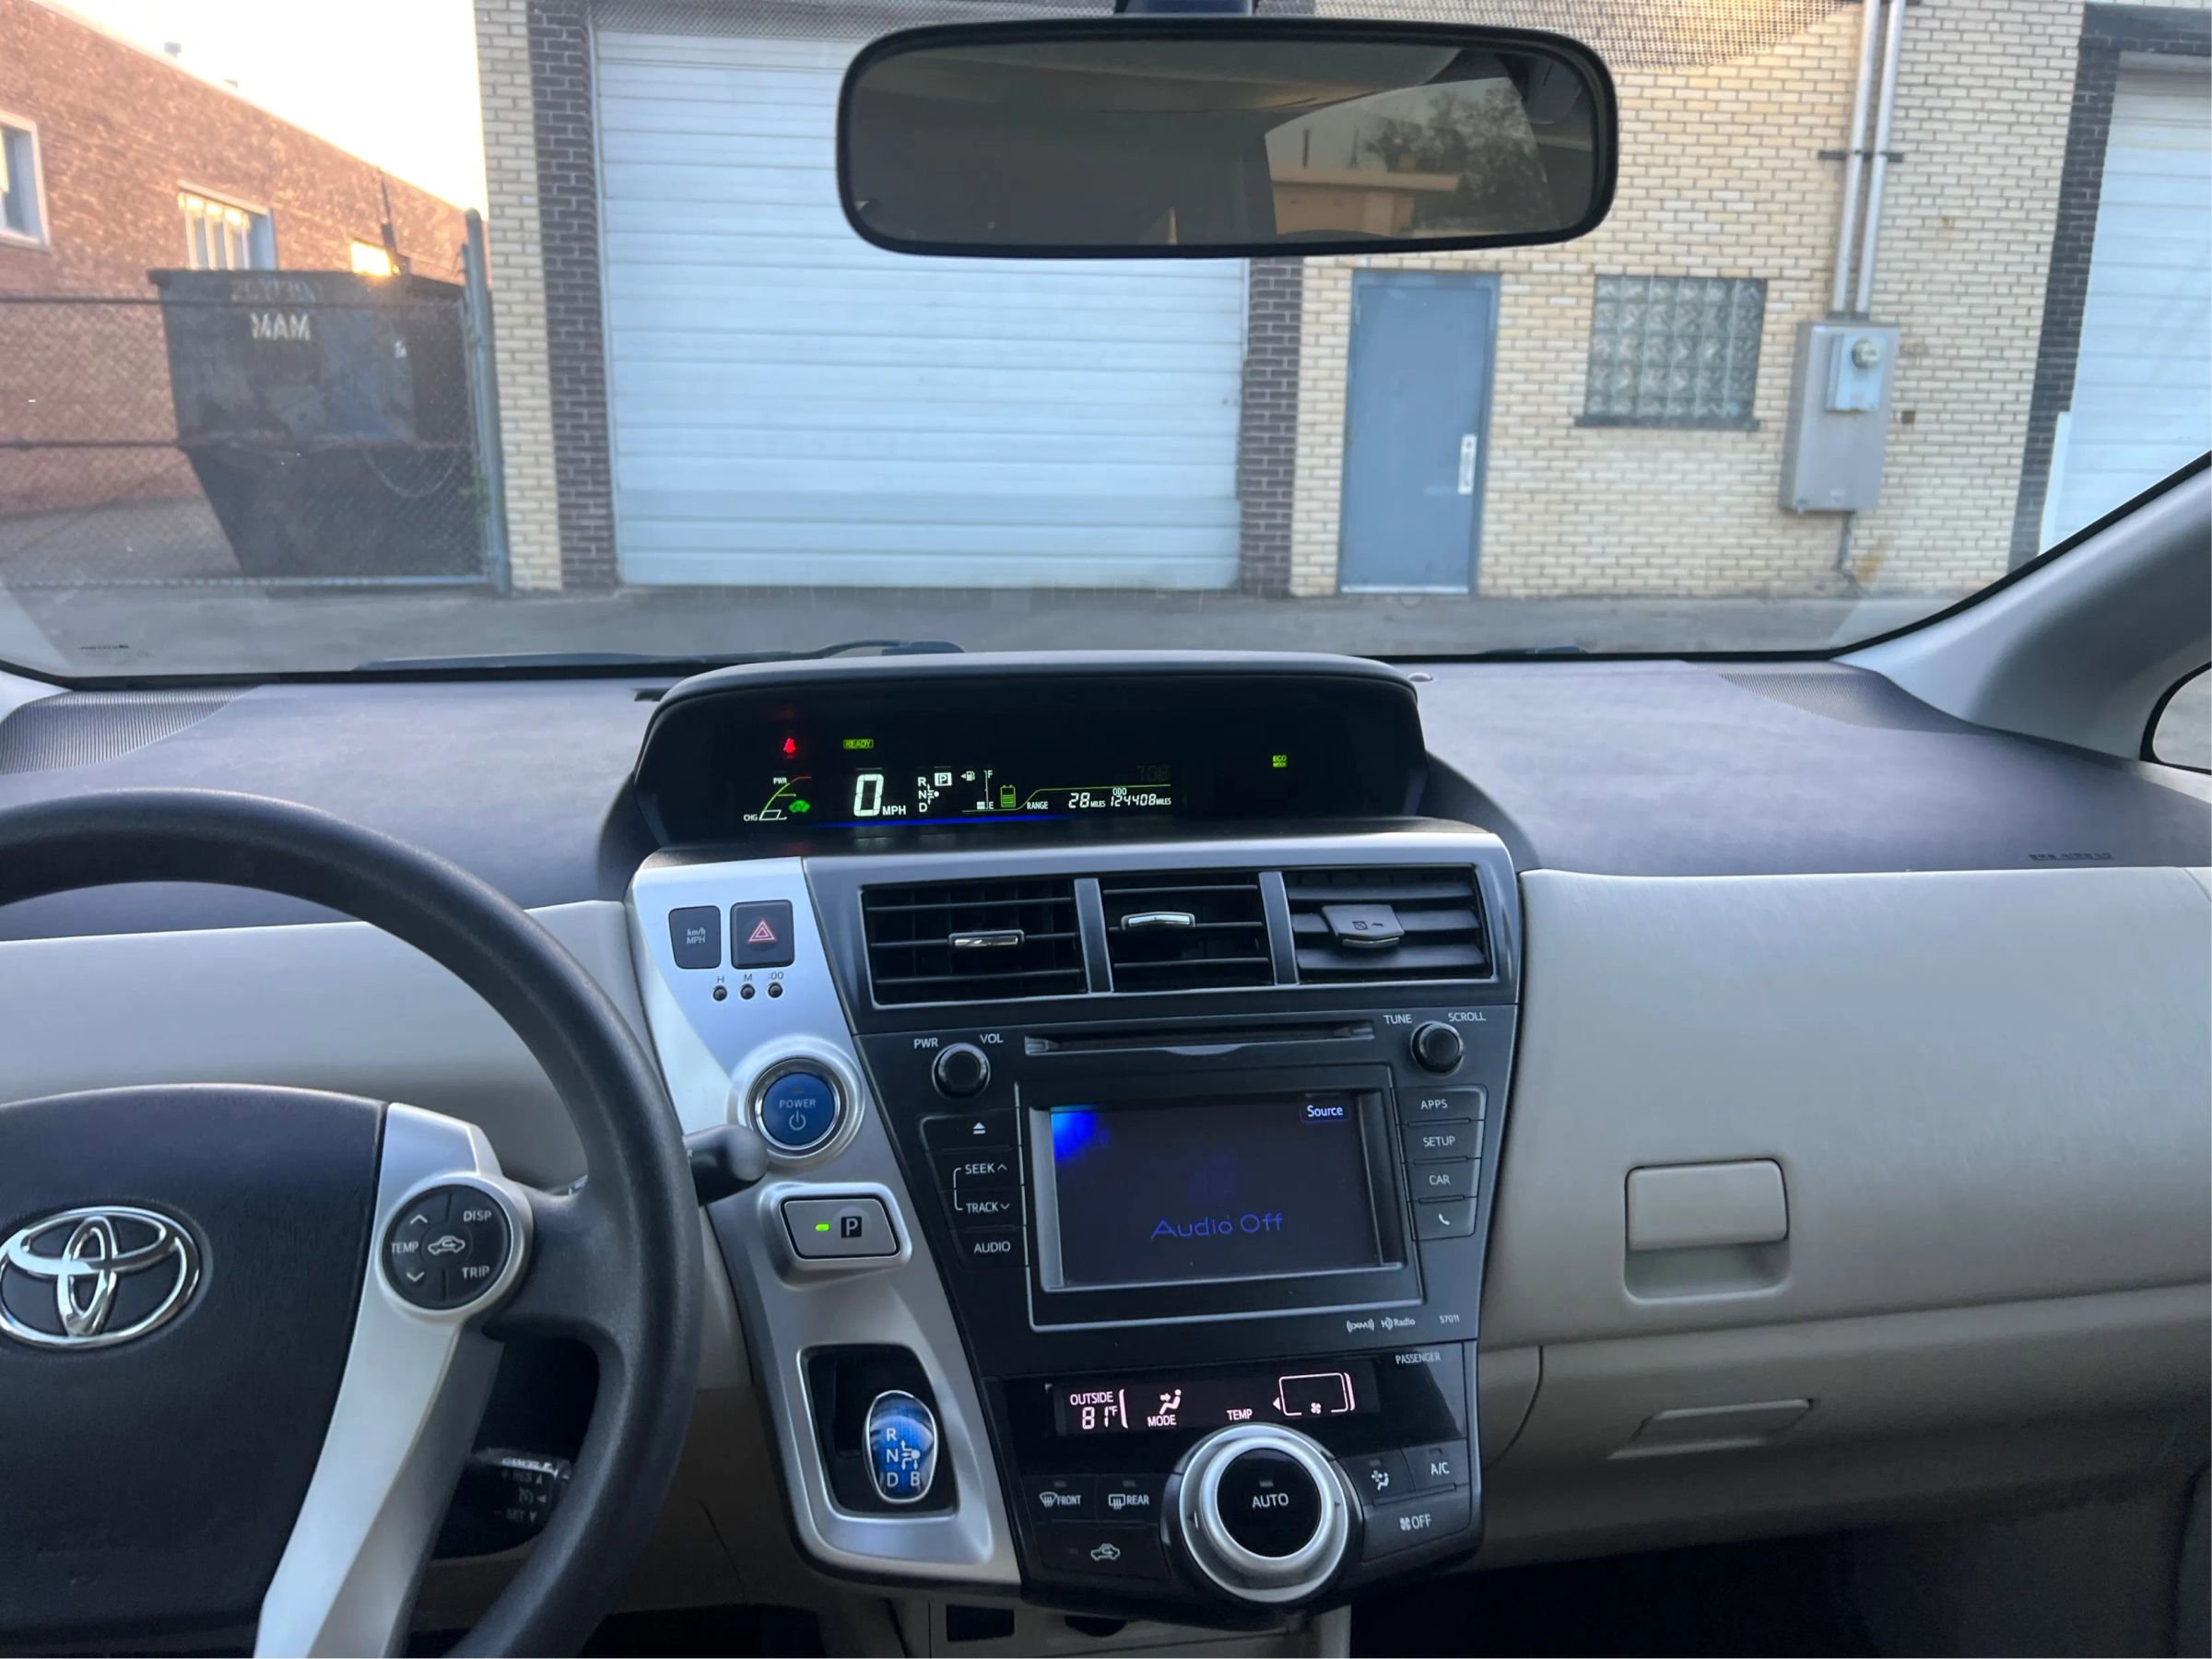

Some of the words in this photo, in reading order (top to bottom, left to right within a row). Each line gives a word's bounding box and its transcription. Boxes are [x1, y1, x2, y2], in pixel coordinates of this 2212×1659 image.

[845, 740, 872, 748] READY
[917, 777, 926, 787] R
[853, 773, 884, 817] 0
[882, 805, 906, 816] MPH
[918, 790, 927, 799] N
[1112, 787, 1127, 795] ODO
[1027, 801, 1048, 810] RANGE
[1068, 793, 1090, 808] 28
[1090, 800, 1106, 808] MILES
[1111, 794, 1157, 807] 124408
[1156, 797, 1171, 806] MILES
[919, 803, 927, 812] D
[743, 813, 759, 821] CHG
[687, 927, 706, 935] km/h
[686, 935, 705, 945] MPH
[717, 975, 724, 983] H
[744, 973, 752, 982] M
[1383, 1014, 1412, 1025] TUNE
[1448, 1012, 1486, 1022] SCROLL
[913, 1038, 939, 1049] PWR
[980, 1033, 1004, 1044] VOL
[779, 1099, 816, 1109] POWER
[1420, 1099, 1448, 1110] APPS
[1307, 1104, 1344, 1117] Source
[1423, 1135, 1455, 1147] SETUP
[965, 1163, 994, 1175] SEEK
[1429, 1174, 1450, 1186] CAR
[966, 1202, 998, 1213] TRACK
[464, 1210, 492, 1222] DISP
[845, 1218, 859, 1236] P
[1151, 1217, 1233, 1240] Audio
[1240, 1212, 1283, 1233] Off
[391, 1241, 419, 1254] TEMP
[973, 1241, 1011, 1254] AUDIO
[462, 1265, 490, 1279] TRIP
[1394, 1317, 1416, 1327] Radio
[1395, 1351, 1441, 1365] PASSENGER
[1070, 1391, 1113, 1406] OUTSIDE
[1227, 1408, 1253, 1420] TEMP
[1147, 1414, 1177, 1427] MODE
[886, 1428, 898, 1441] R
[886, 1449, 899, 1463] N
[1430, 1462, 1451, 1476] A/C
[887, 1472, 899, 1487] D
[911, 1471, 921, 1487] B
[1056, 1495, 1081, 1505] FRONT
[1126, 1494, 1149, 1505] REAR
[1252, 1492, 1289, 1510] AUTO
[1412, 1513, 1431, 1530] OFF
